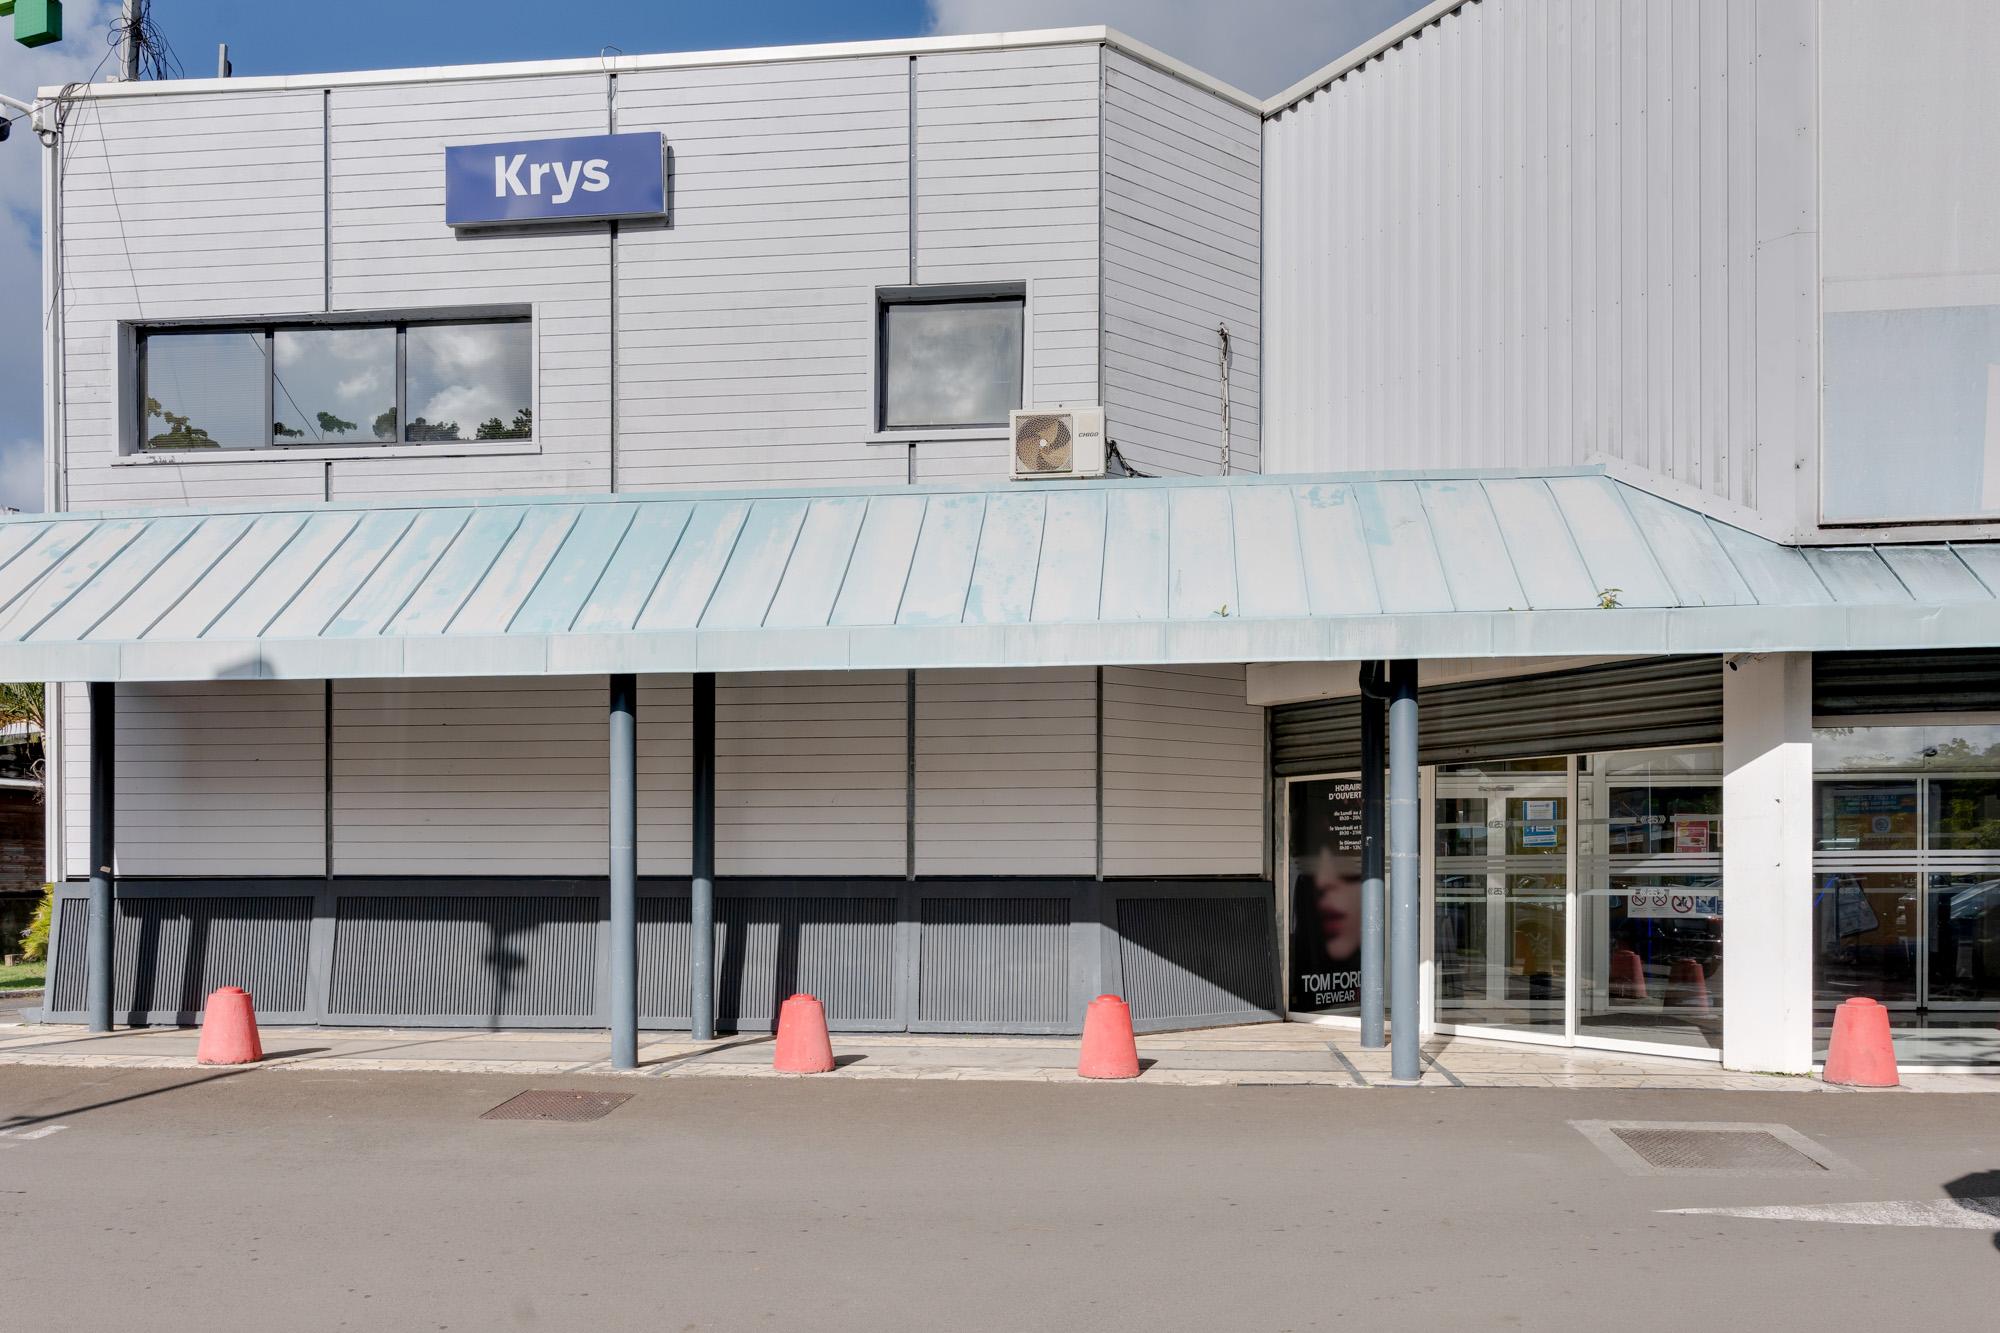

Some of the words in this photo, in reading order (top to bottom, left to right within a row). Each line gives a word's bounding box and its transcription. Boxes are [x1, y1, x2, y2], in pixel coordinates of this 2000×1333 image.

[495, 153, 610, 204] Krys
[1301, 973, 1331, 992] TOM
[1315, 990, 1356, 1005] EYEWEAR
